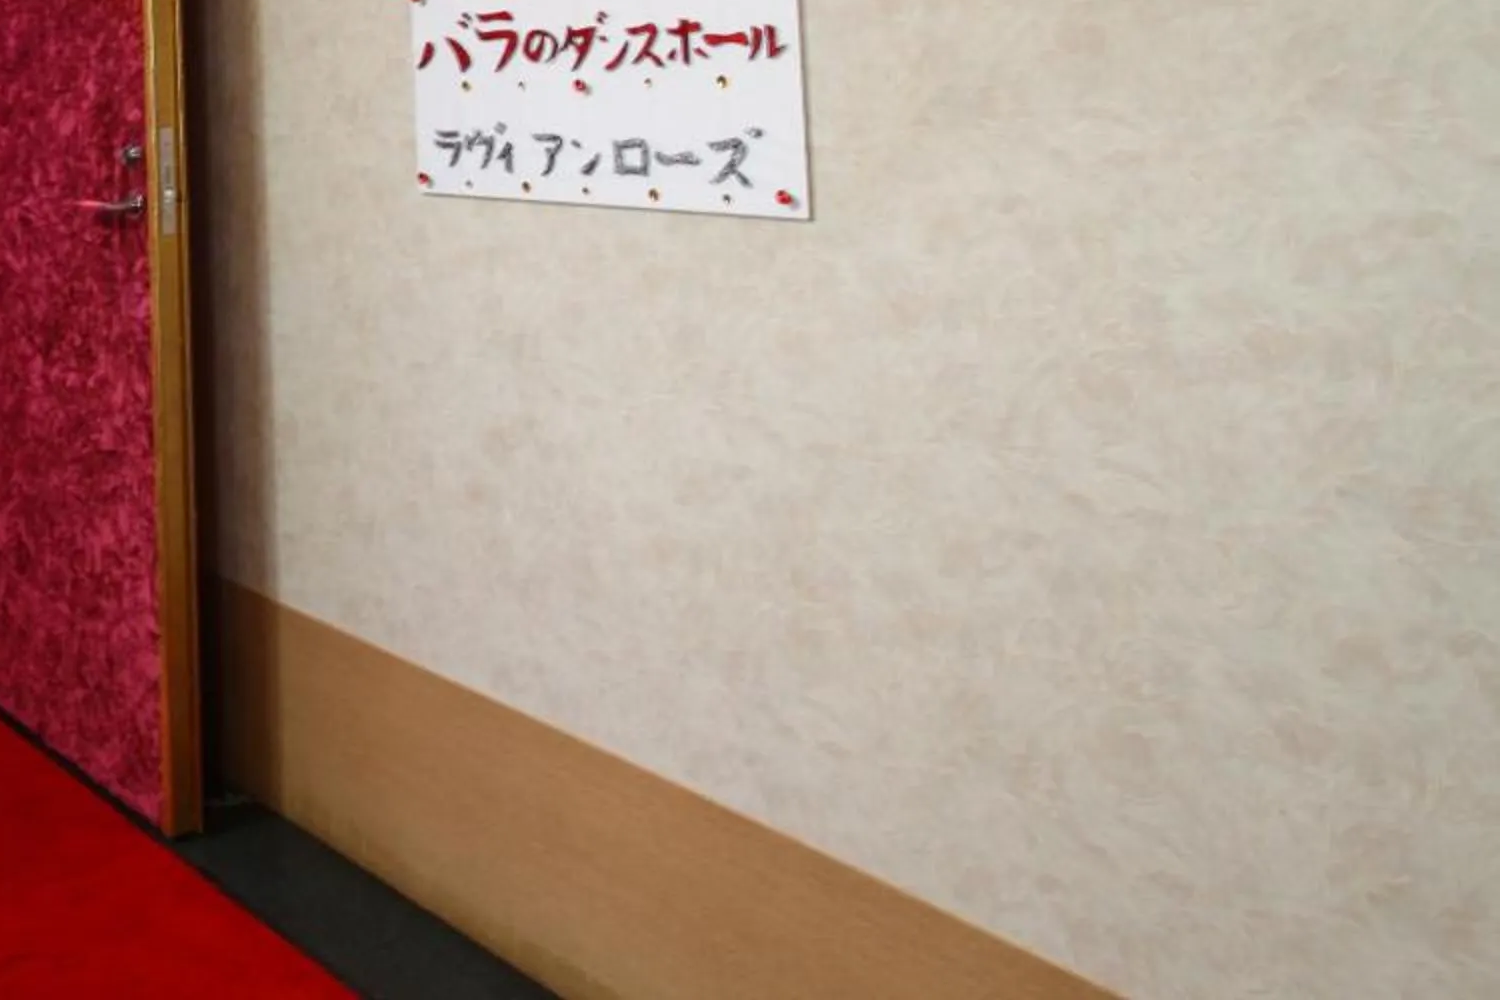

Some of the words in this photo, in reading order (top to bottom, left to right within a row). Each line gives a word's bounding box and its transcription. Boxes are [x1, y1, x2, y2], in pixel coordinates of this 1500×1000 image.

[417, 11, 786, 72] バラのダンスホール
